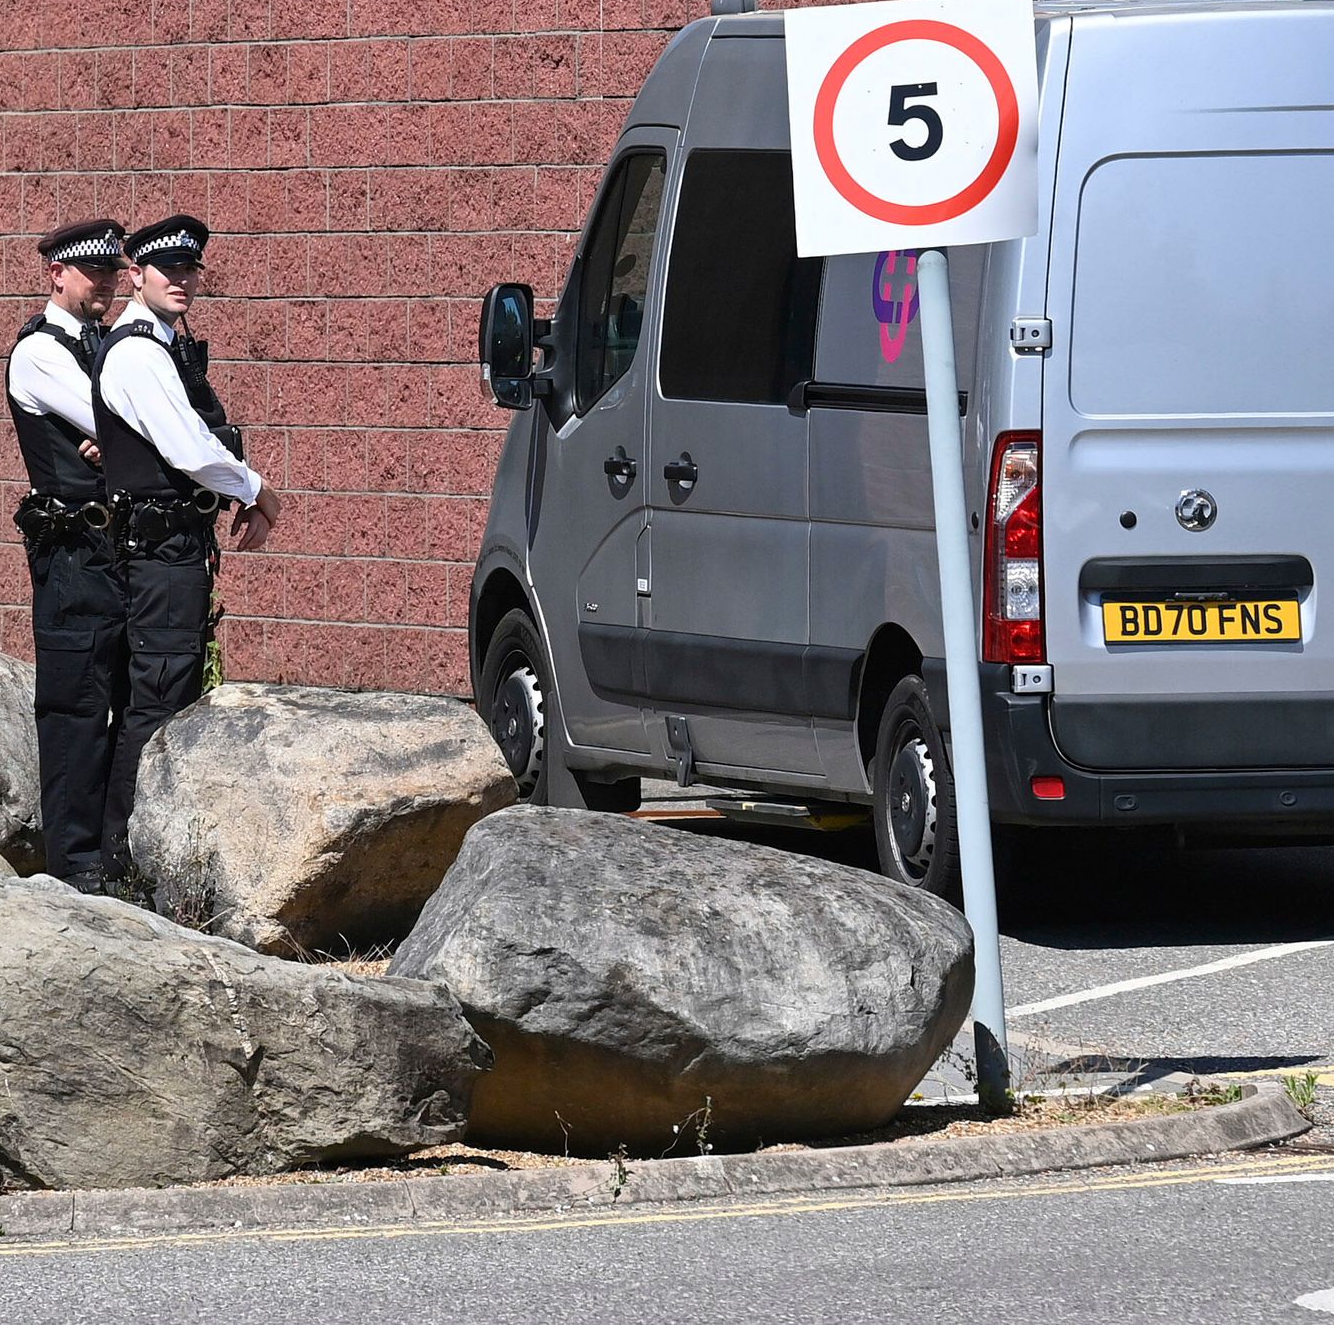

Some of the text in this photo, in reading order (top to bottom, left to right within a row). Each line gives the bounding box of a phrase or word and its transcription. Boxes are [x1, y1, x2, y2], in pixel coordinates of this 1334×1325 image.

[887, 82, 944, 162] 5
[1120, 603, 1284, 637] BD70 FNS
